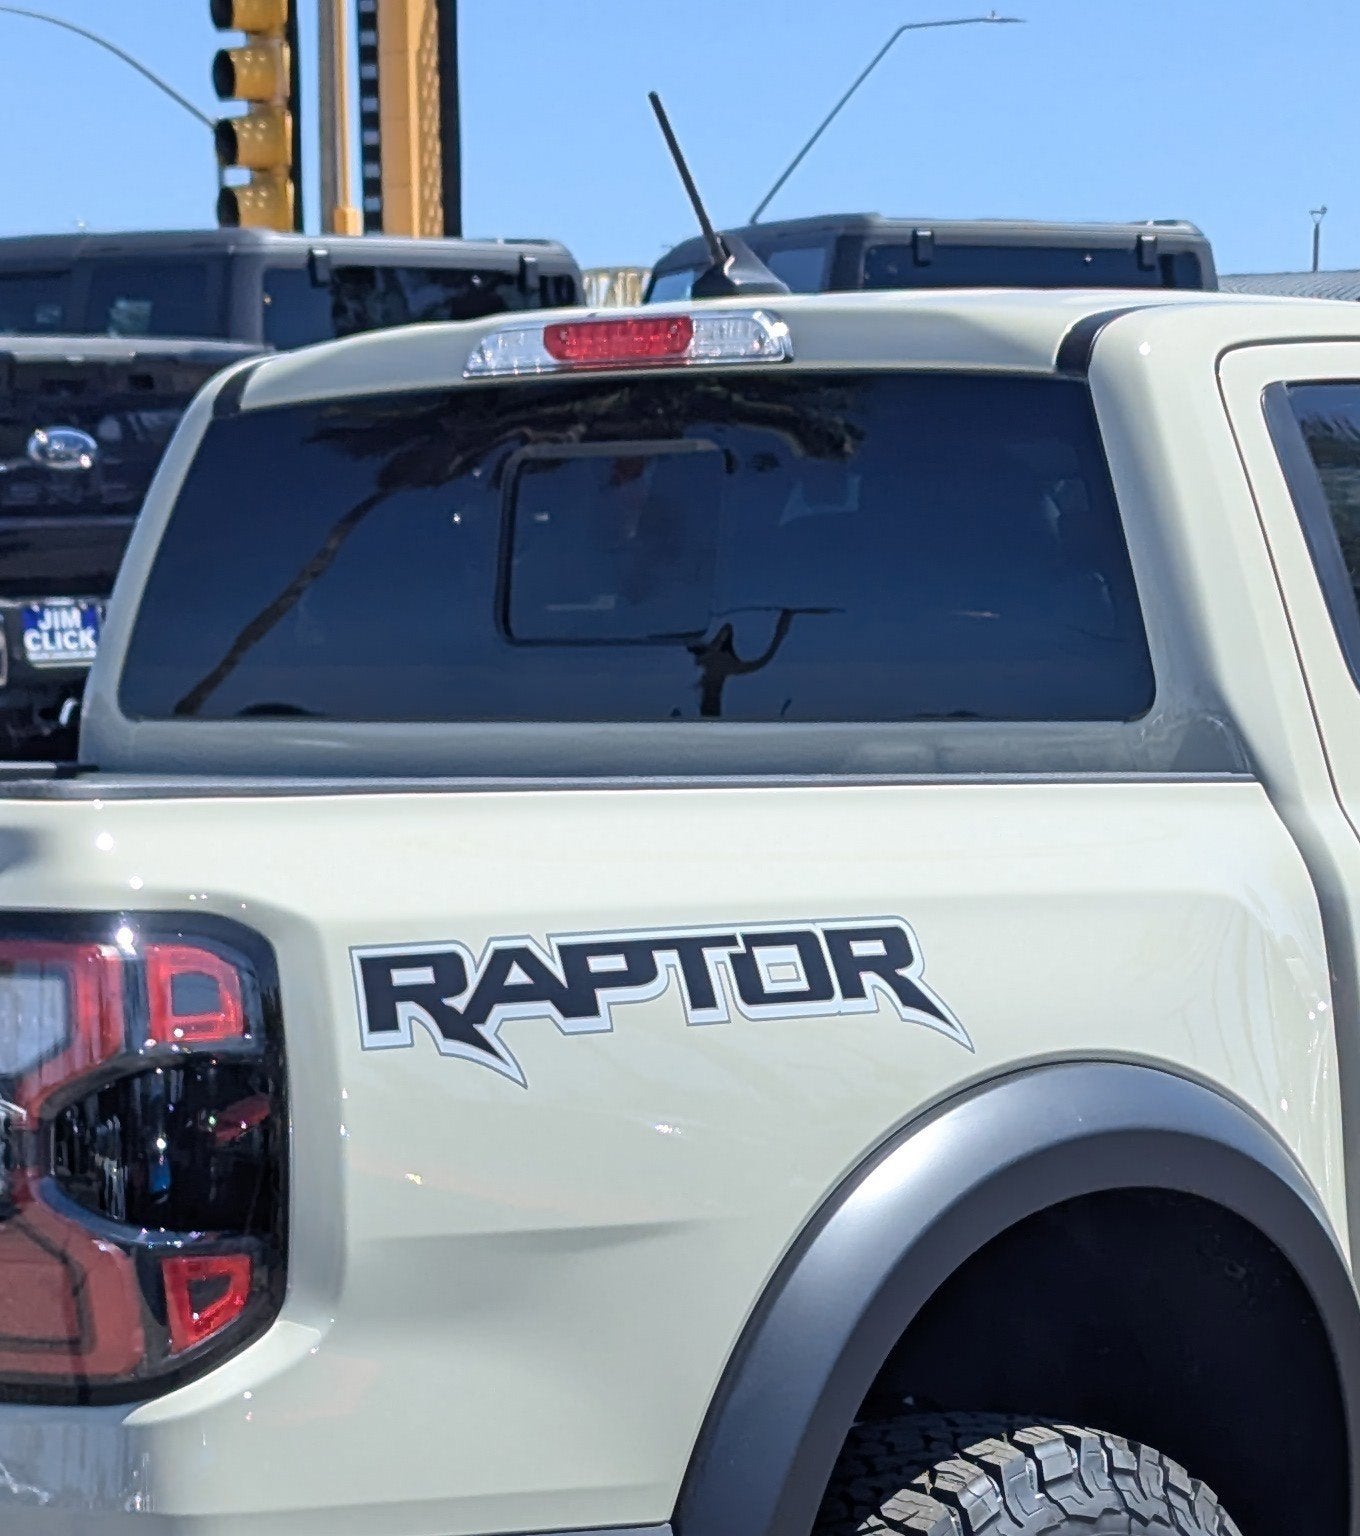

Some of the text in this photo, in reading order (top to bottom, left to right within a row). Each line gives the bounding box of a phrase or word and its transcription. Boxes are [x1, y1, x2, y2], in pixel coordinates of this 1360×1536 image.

[37, 607, 83, 631] JIM
[23, 628, 97, 651] CLICK
[349, 915, 975, 1089] RAPTOR
